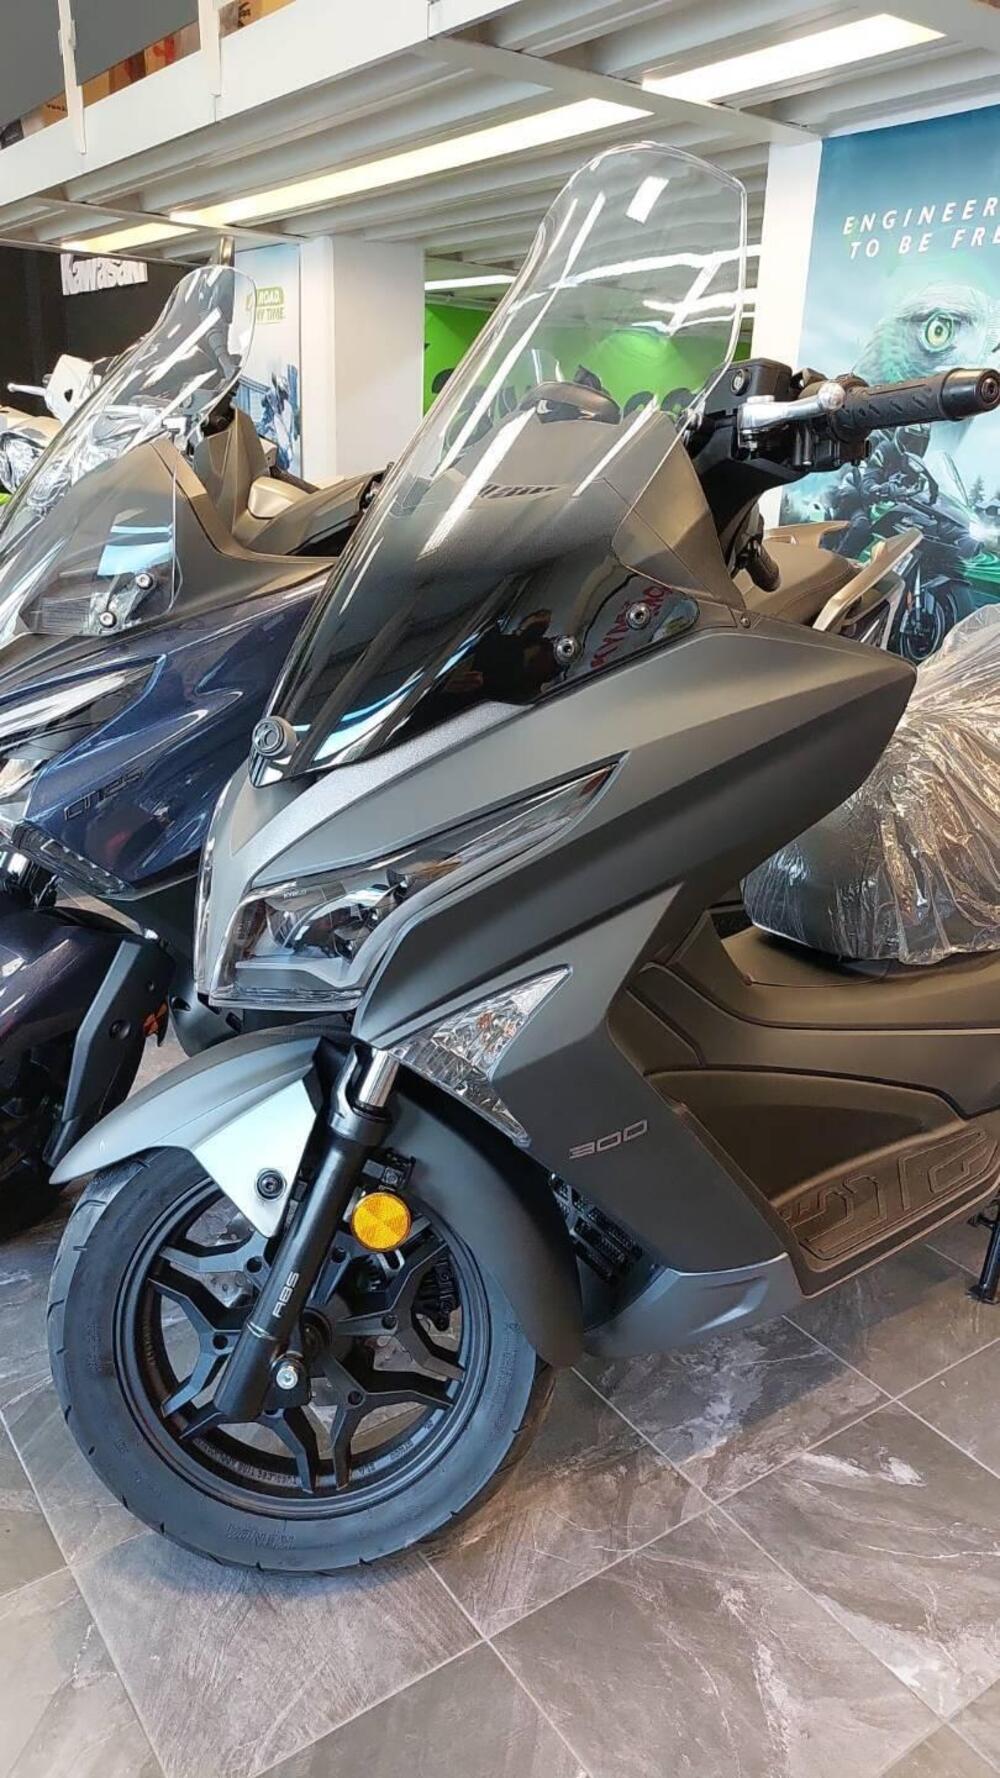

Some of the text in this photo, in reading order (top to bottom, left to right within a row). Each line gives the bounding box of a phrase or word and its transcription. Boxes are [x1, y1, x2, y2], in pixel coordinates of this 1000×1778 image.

[850, 239, 880, 260] TO
[898, 233, 934, 254] BE
[568, 1119, 648, 1160] 300
[272, 1271, 300, 1318] ABS
